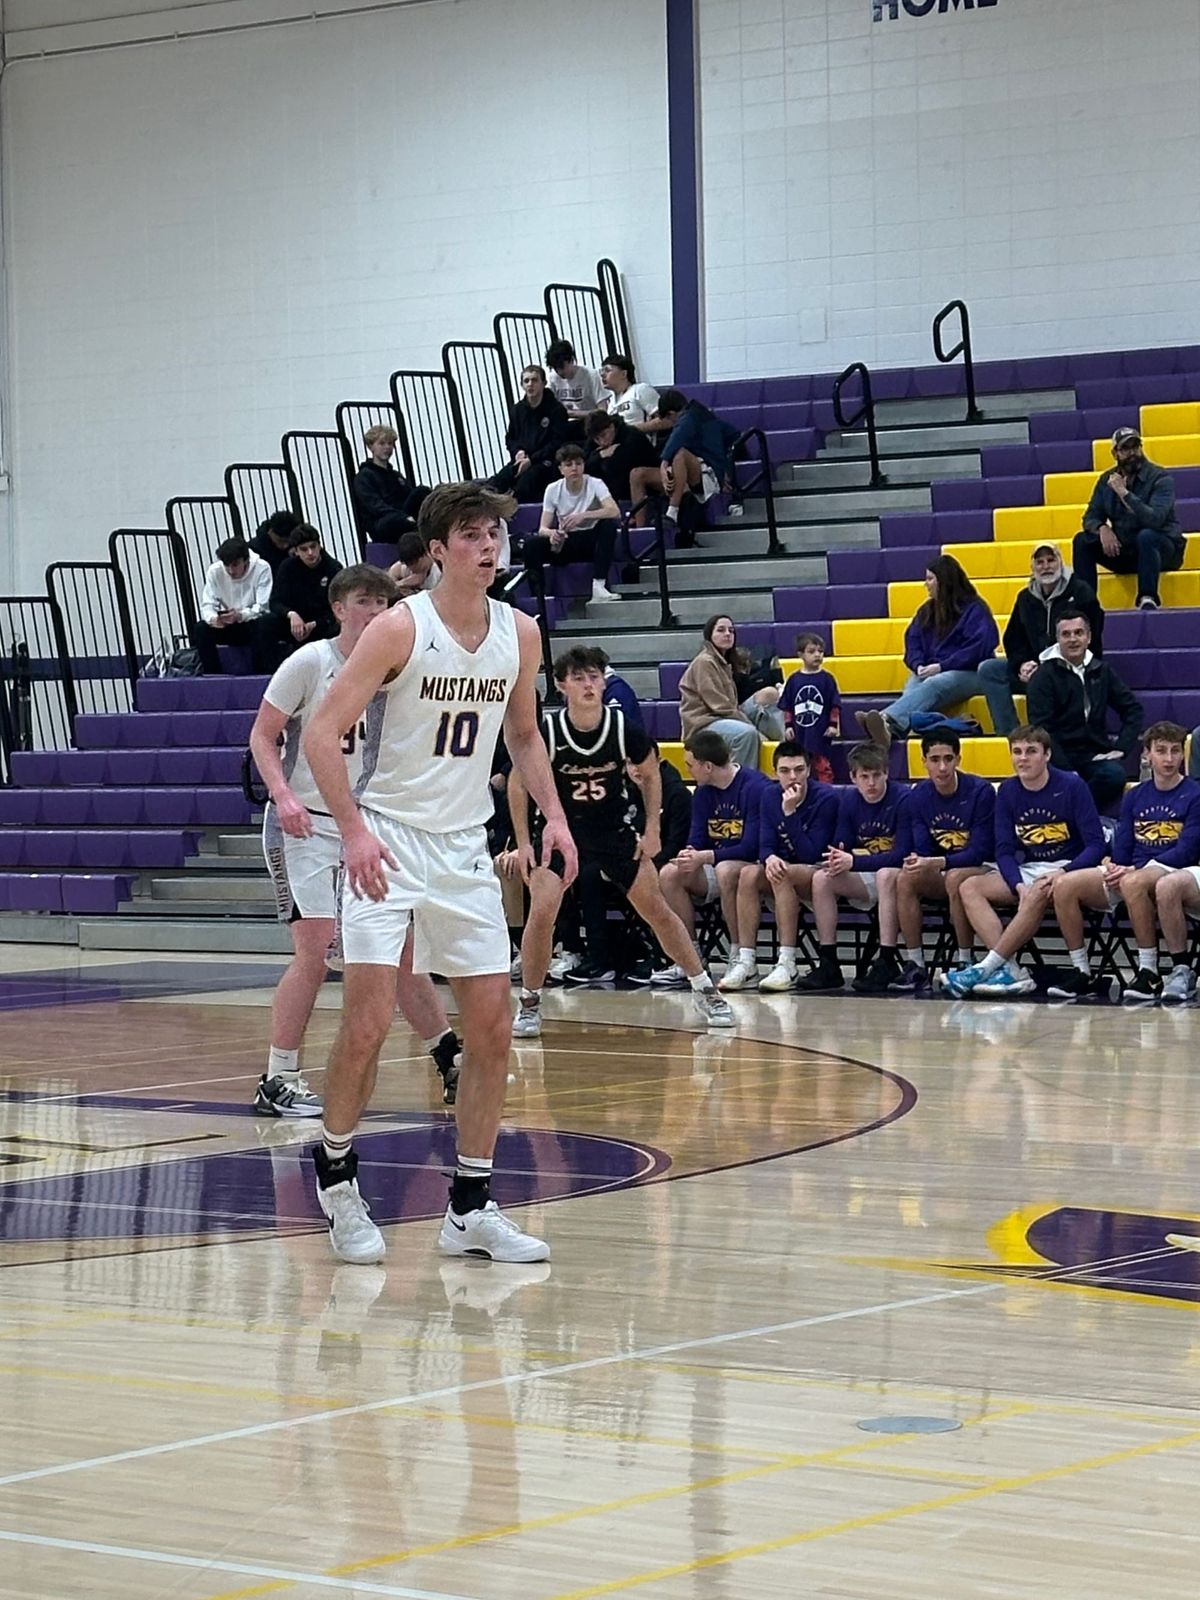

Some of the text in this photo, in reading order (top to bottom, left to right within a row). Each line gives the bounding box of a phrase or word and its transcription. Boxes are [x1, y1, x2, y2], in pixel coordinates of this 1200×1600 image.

[873, 0, 998, 22] HO
[419, 675, 508, 703] MUSTANGS
[432, 710, 480, 758] 10
[571, 777, 608, 801] 25
[268, 846, 290, 914] MUSTANGS
